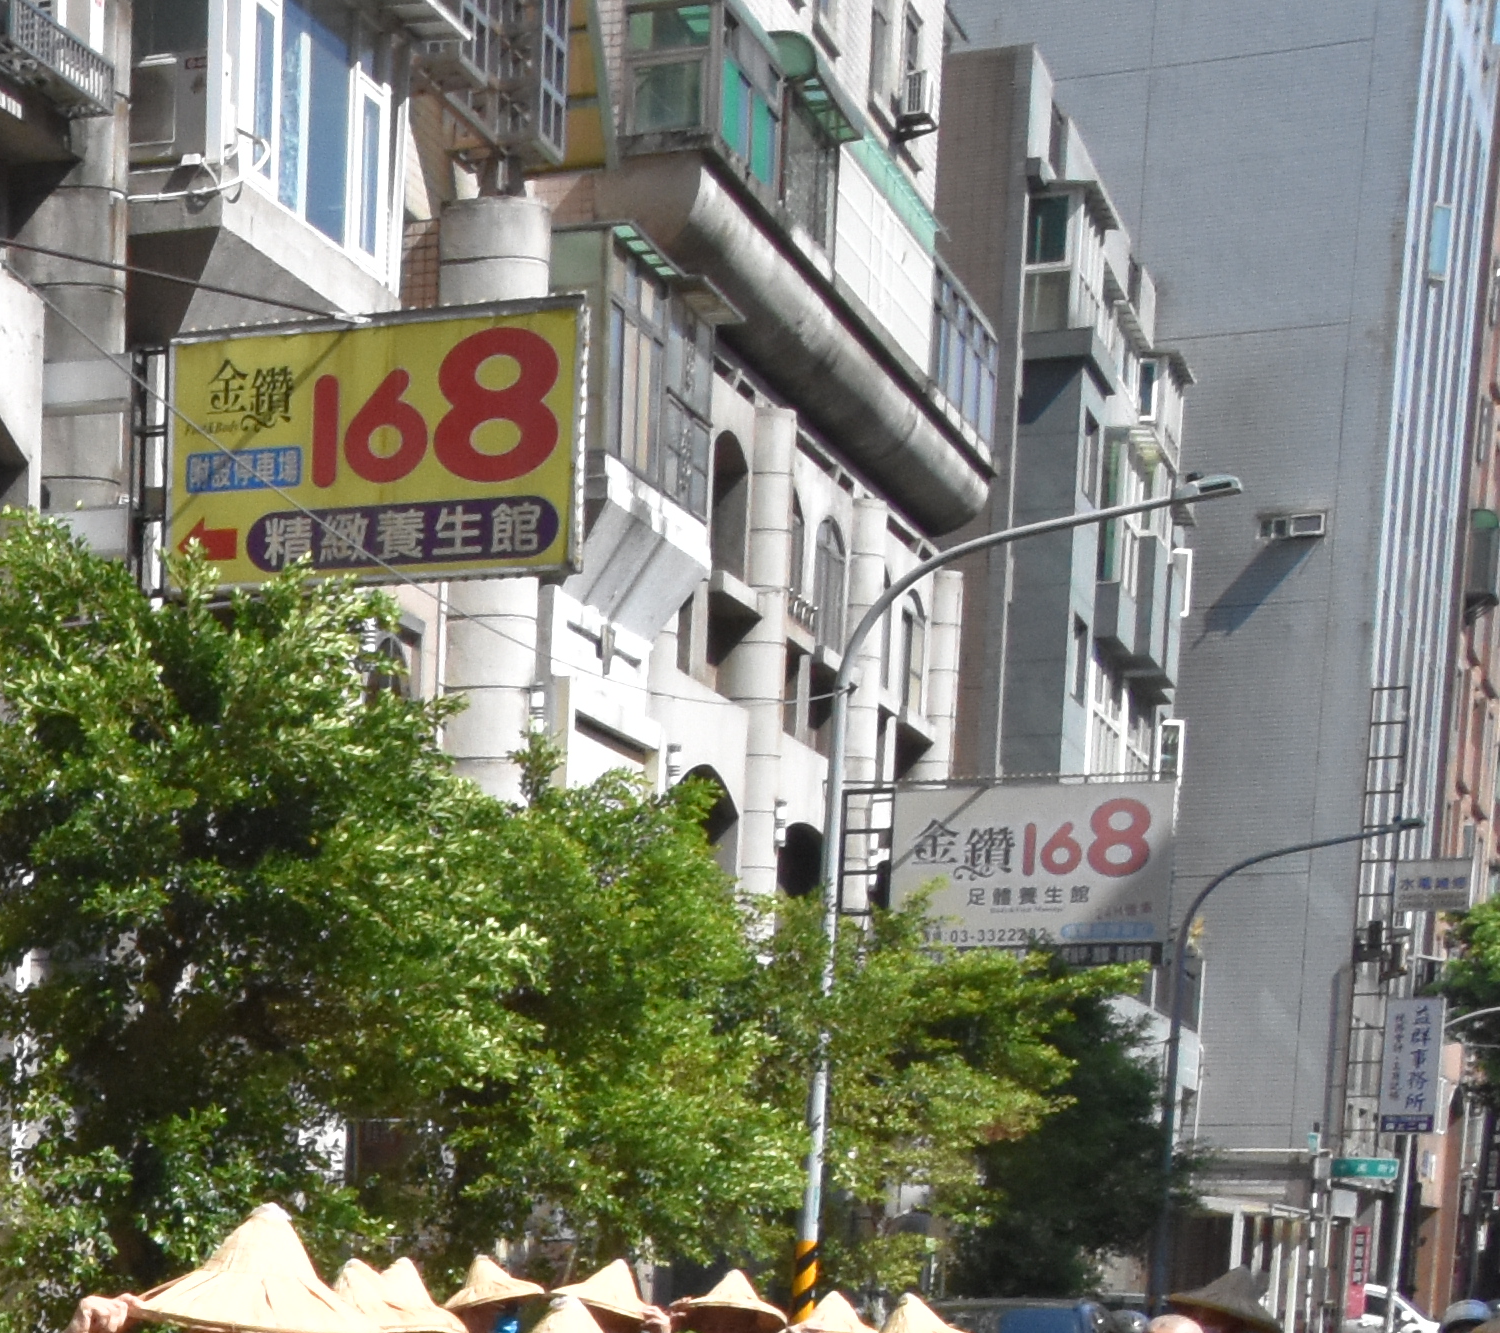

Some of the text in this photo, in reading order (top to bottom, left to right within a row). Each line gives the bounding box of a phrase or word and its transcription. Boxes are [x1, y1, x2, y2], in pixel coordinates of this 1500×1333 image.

[207, 326, 560, 489] 金鑽 168
[263, 502, 542, 568] 精緻養生館
[911, 797, 1152, 881] 金鑽 168
